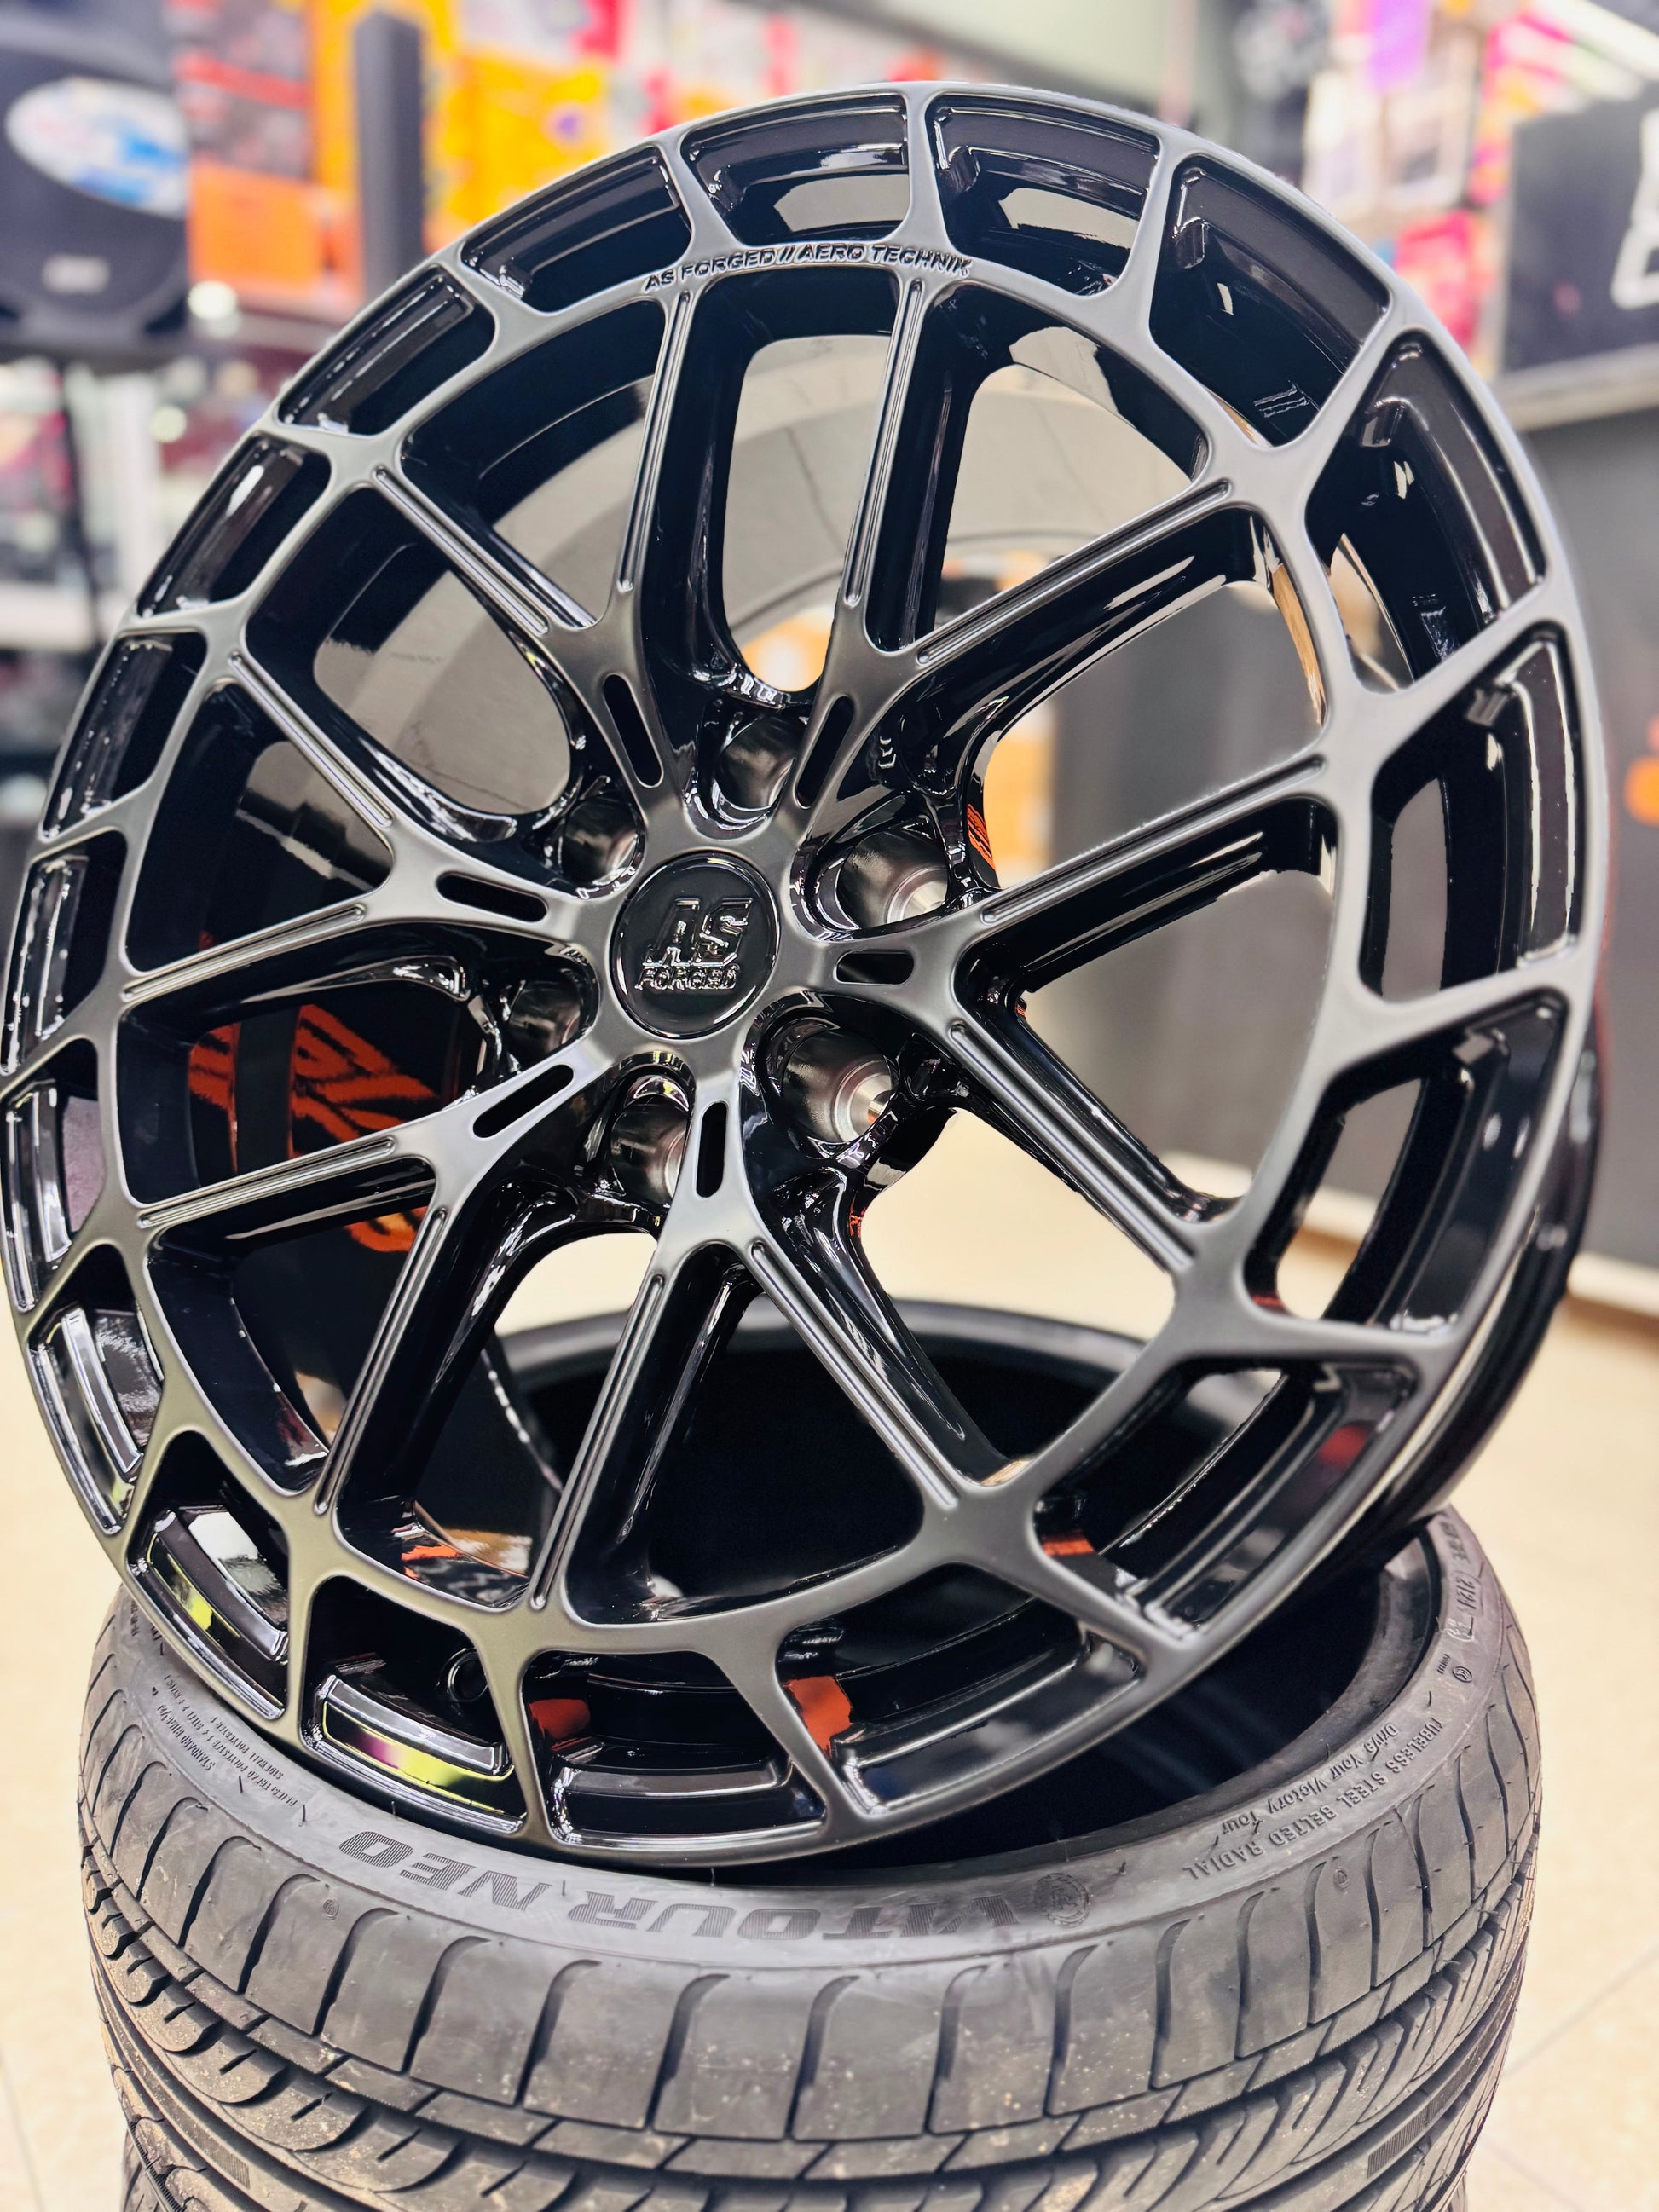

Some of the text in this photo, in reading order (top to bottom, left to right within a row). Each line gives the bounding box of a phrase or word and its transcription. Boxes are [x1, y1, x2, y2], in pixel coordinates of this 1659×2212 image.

[643, 269, 676, 292] AS
[680, 247, 777, 282] FORGED
[796, 243, 866, 263] AERO
[870, 244, 973, 277] TECHNIK
[643, 896, 754, 967] AS
[634, 964, 740, 990] FORGED
[180, 1734, 216, 1771] STANDARD
[1222, 1723, 1400, 1834] Drive Your Victory Tour
[1182, 1717, 1443, 1880] TUBELESS STEEL BELTED RADIAL
[338, 1831, 552, 1911] NEO
[568, 1890, 1021, 1940] VITOUR
